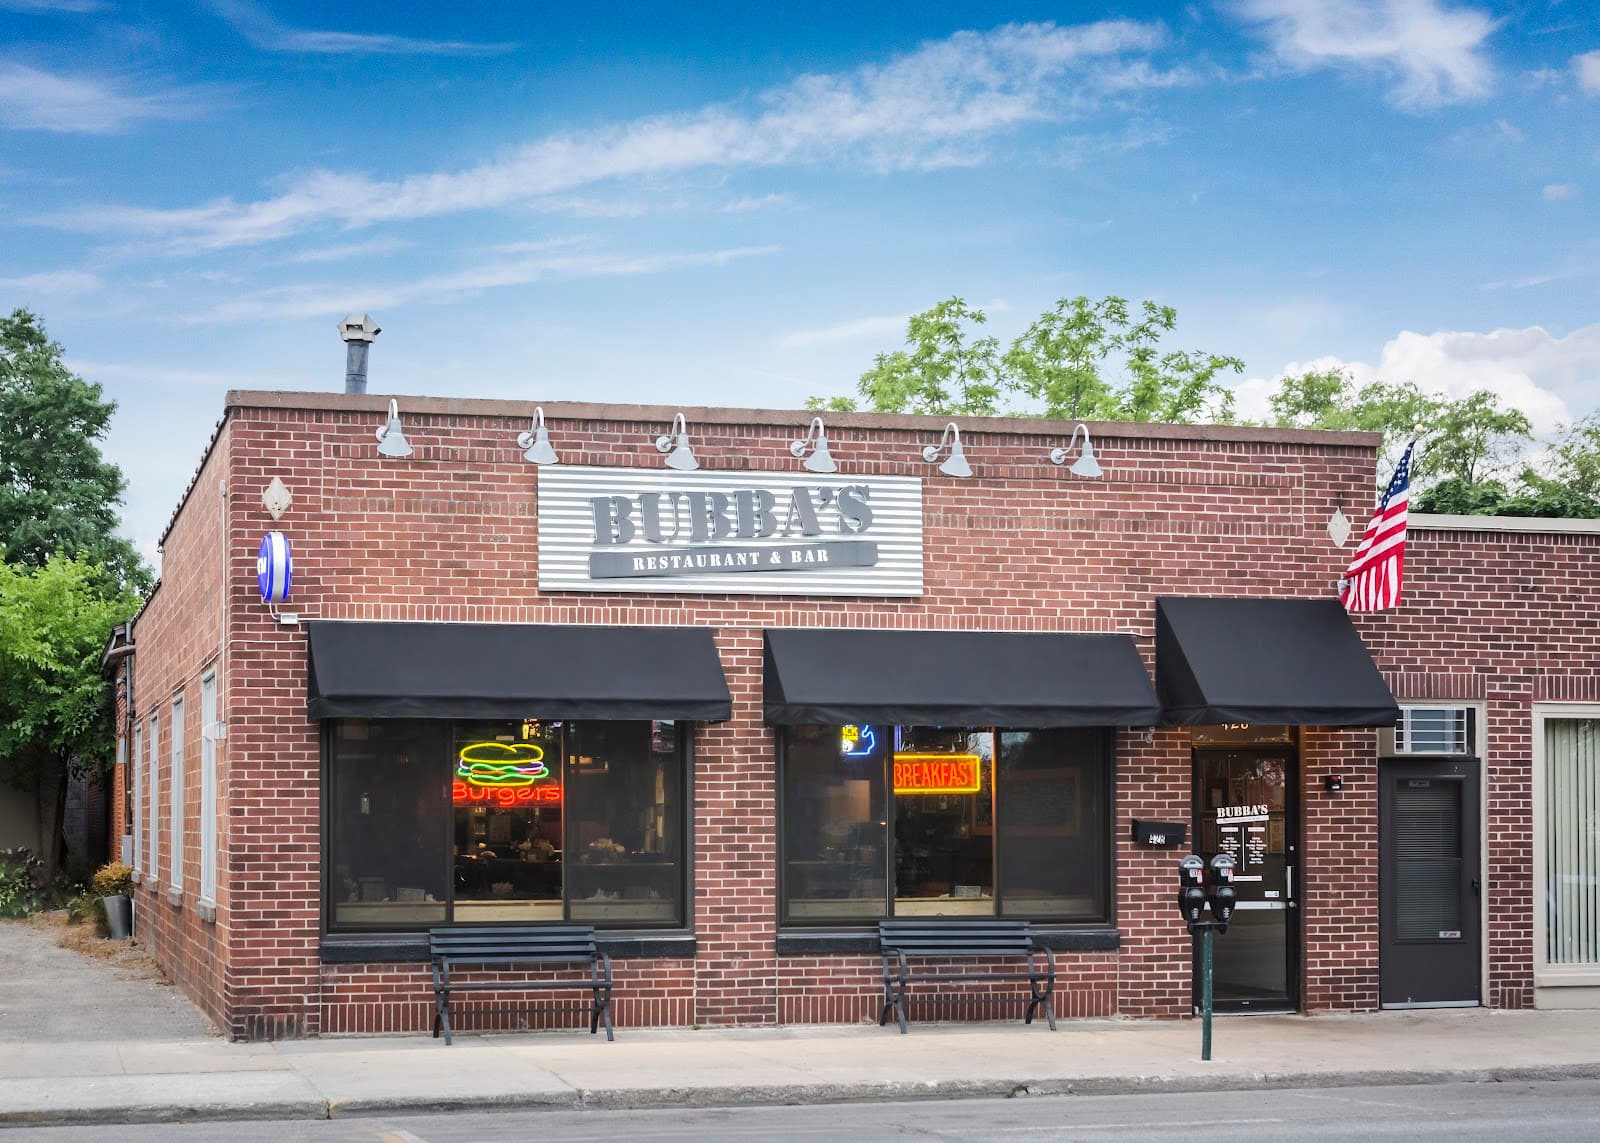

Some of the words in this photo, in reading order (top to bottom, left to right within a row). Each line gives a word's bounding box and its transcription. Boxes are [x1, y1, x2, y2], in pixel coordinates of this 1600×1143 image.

[590, 485, 874, 545] BUBBA'S
[632, 552, 761, 571] RESTAURANT
[769, 551, 782, 565] &
[791, 549, 830, 564] BAR
[894, 761, 976, 787] BREAKFAST
[453, 782, 561, 805] Burgers
[1216, 804, 1269, 818] BUBBA'S
